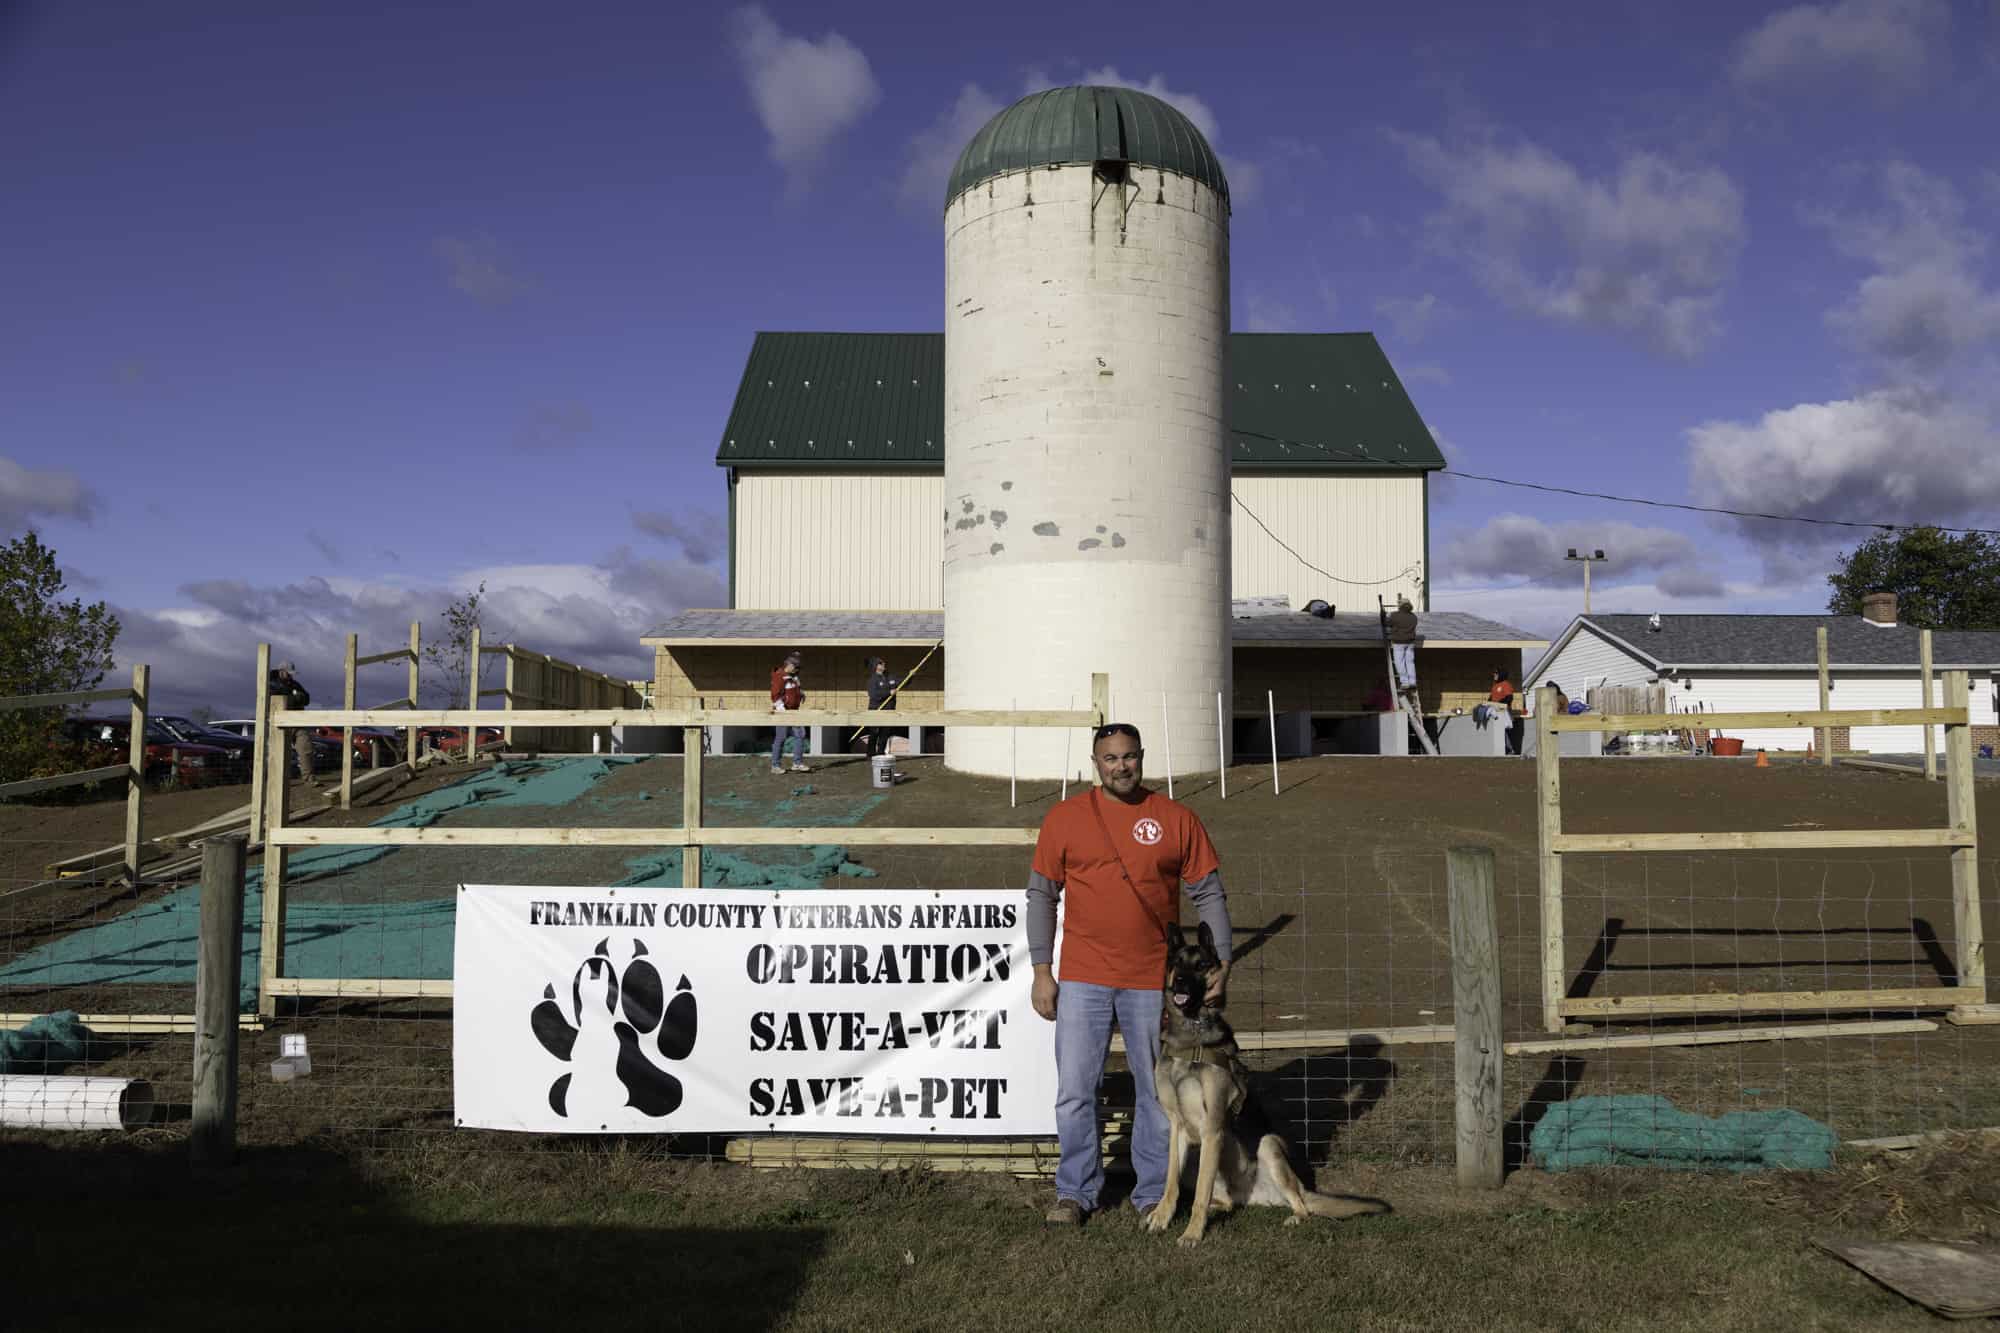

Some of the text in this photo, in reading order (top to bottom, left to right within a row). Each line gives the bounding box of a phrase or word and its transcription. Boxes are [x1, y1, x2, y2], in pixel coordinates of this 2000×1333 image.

[530, 901, 1017, 929] FRANKLIN COUNTY VETERANS AFFAIRS
[746, 943, 1012, 985] OPERATION
[750, 1009, 1008, 1051] SAVE-A-VET
[749, 1076, 1008, 1119] SAVE-A-PET
